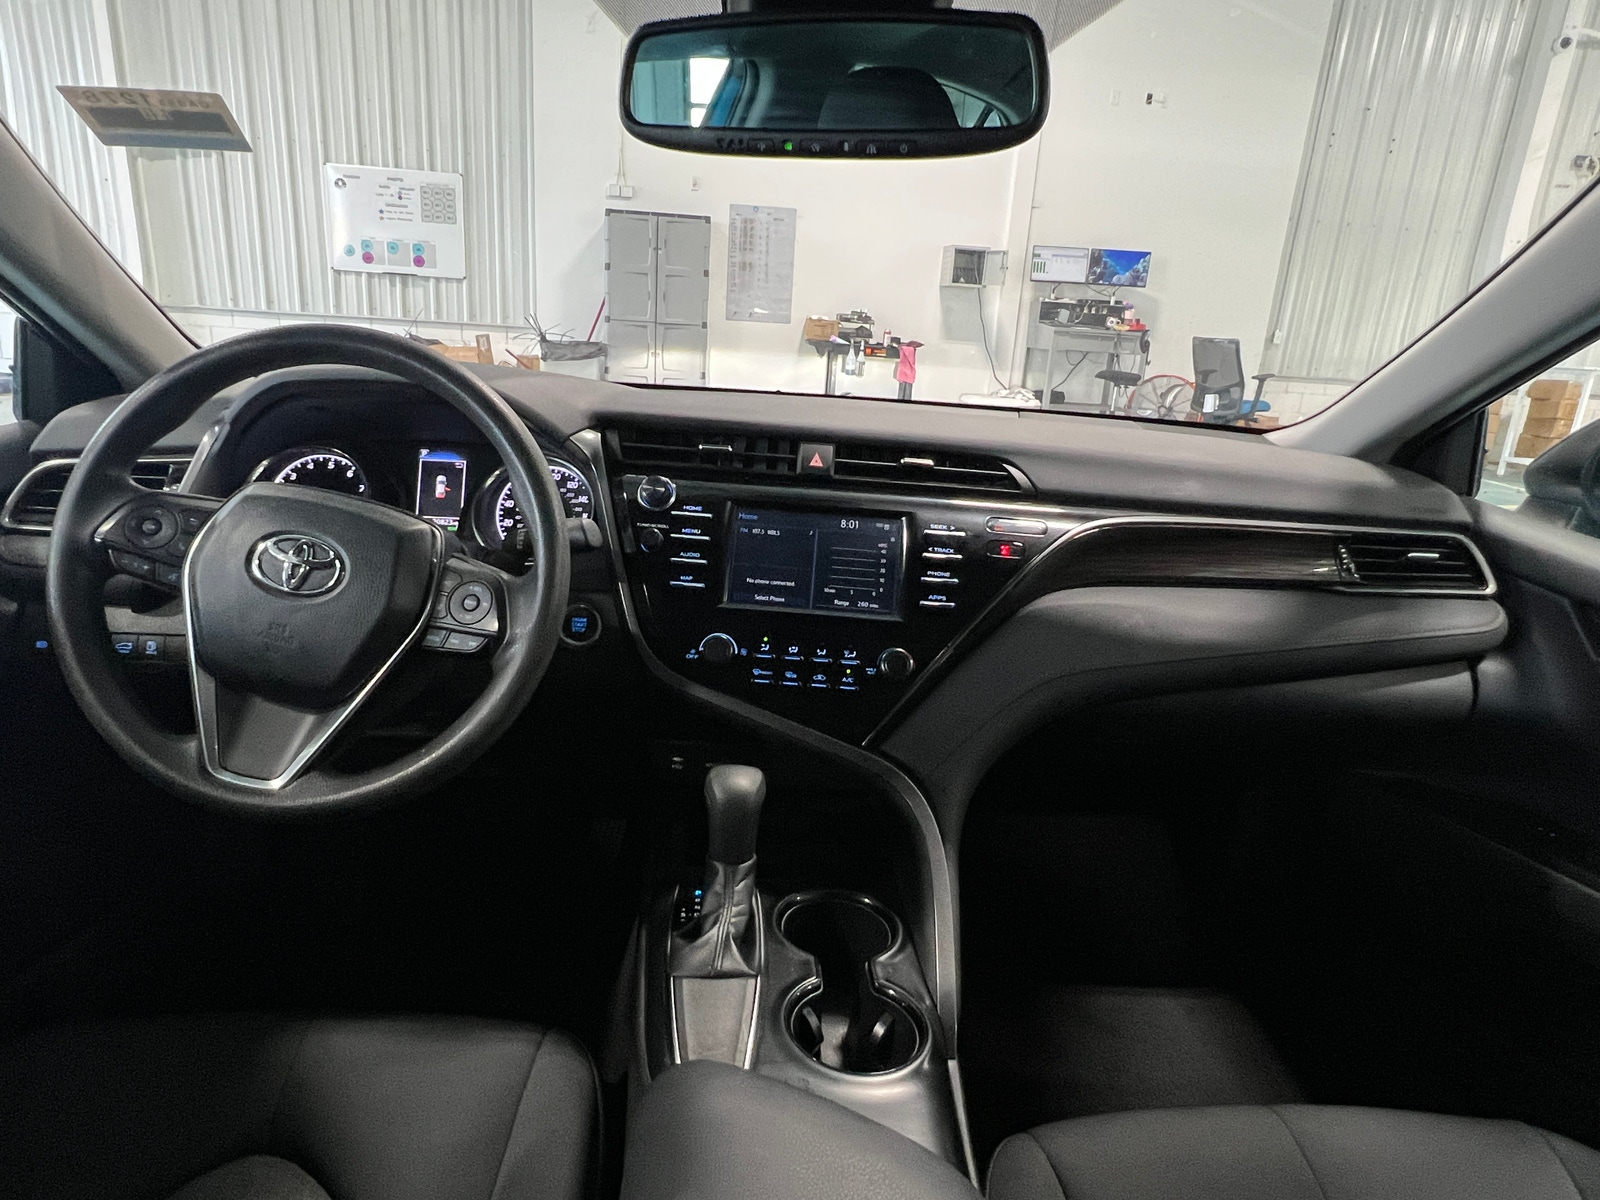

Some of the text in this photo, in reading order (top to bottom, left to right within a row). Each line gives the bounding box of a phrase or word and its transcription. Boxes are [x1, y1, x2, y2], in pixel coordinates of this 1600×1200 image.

[307, 462, 314, 470] 4
[327, 461, 335, 470] 5
[289, 473, 297, 481] 3
[346, 470, 354, 478] 6
[359, 484, 365, 493] 7
[682, 504, 703, 512] HOME
[738, 512, 759, 520] Home
[503, 519, 514, 527] 20
[840, 519, 860, 530] 8:01
[927, 570, 951, 578] PHONE
[834, 599, 850, 607] Range
